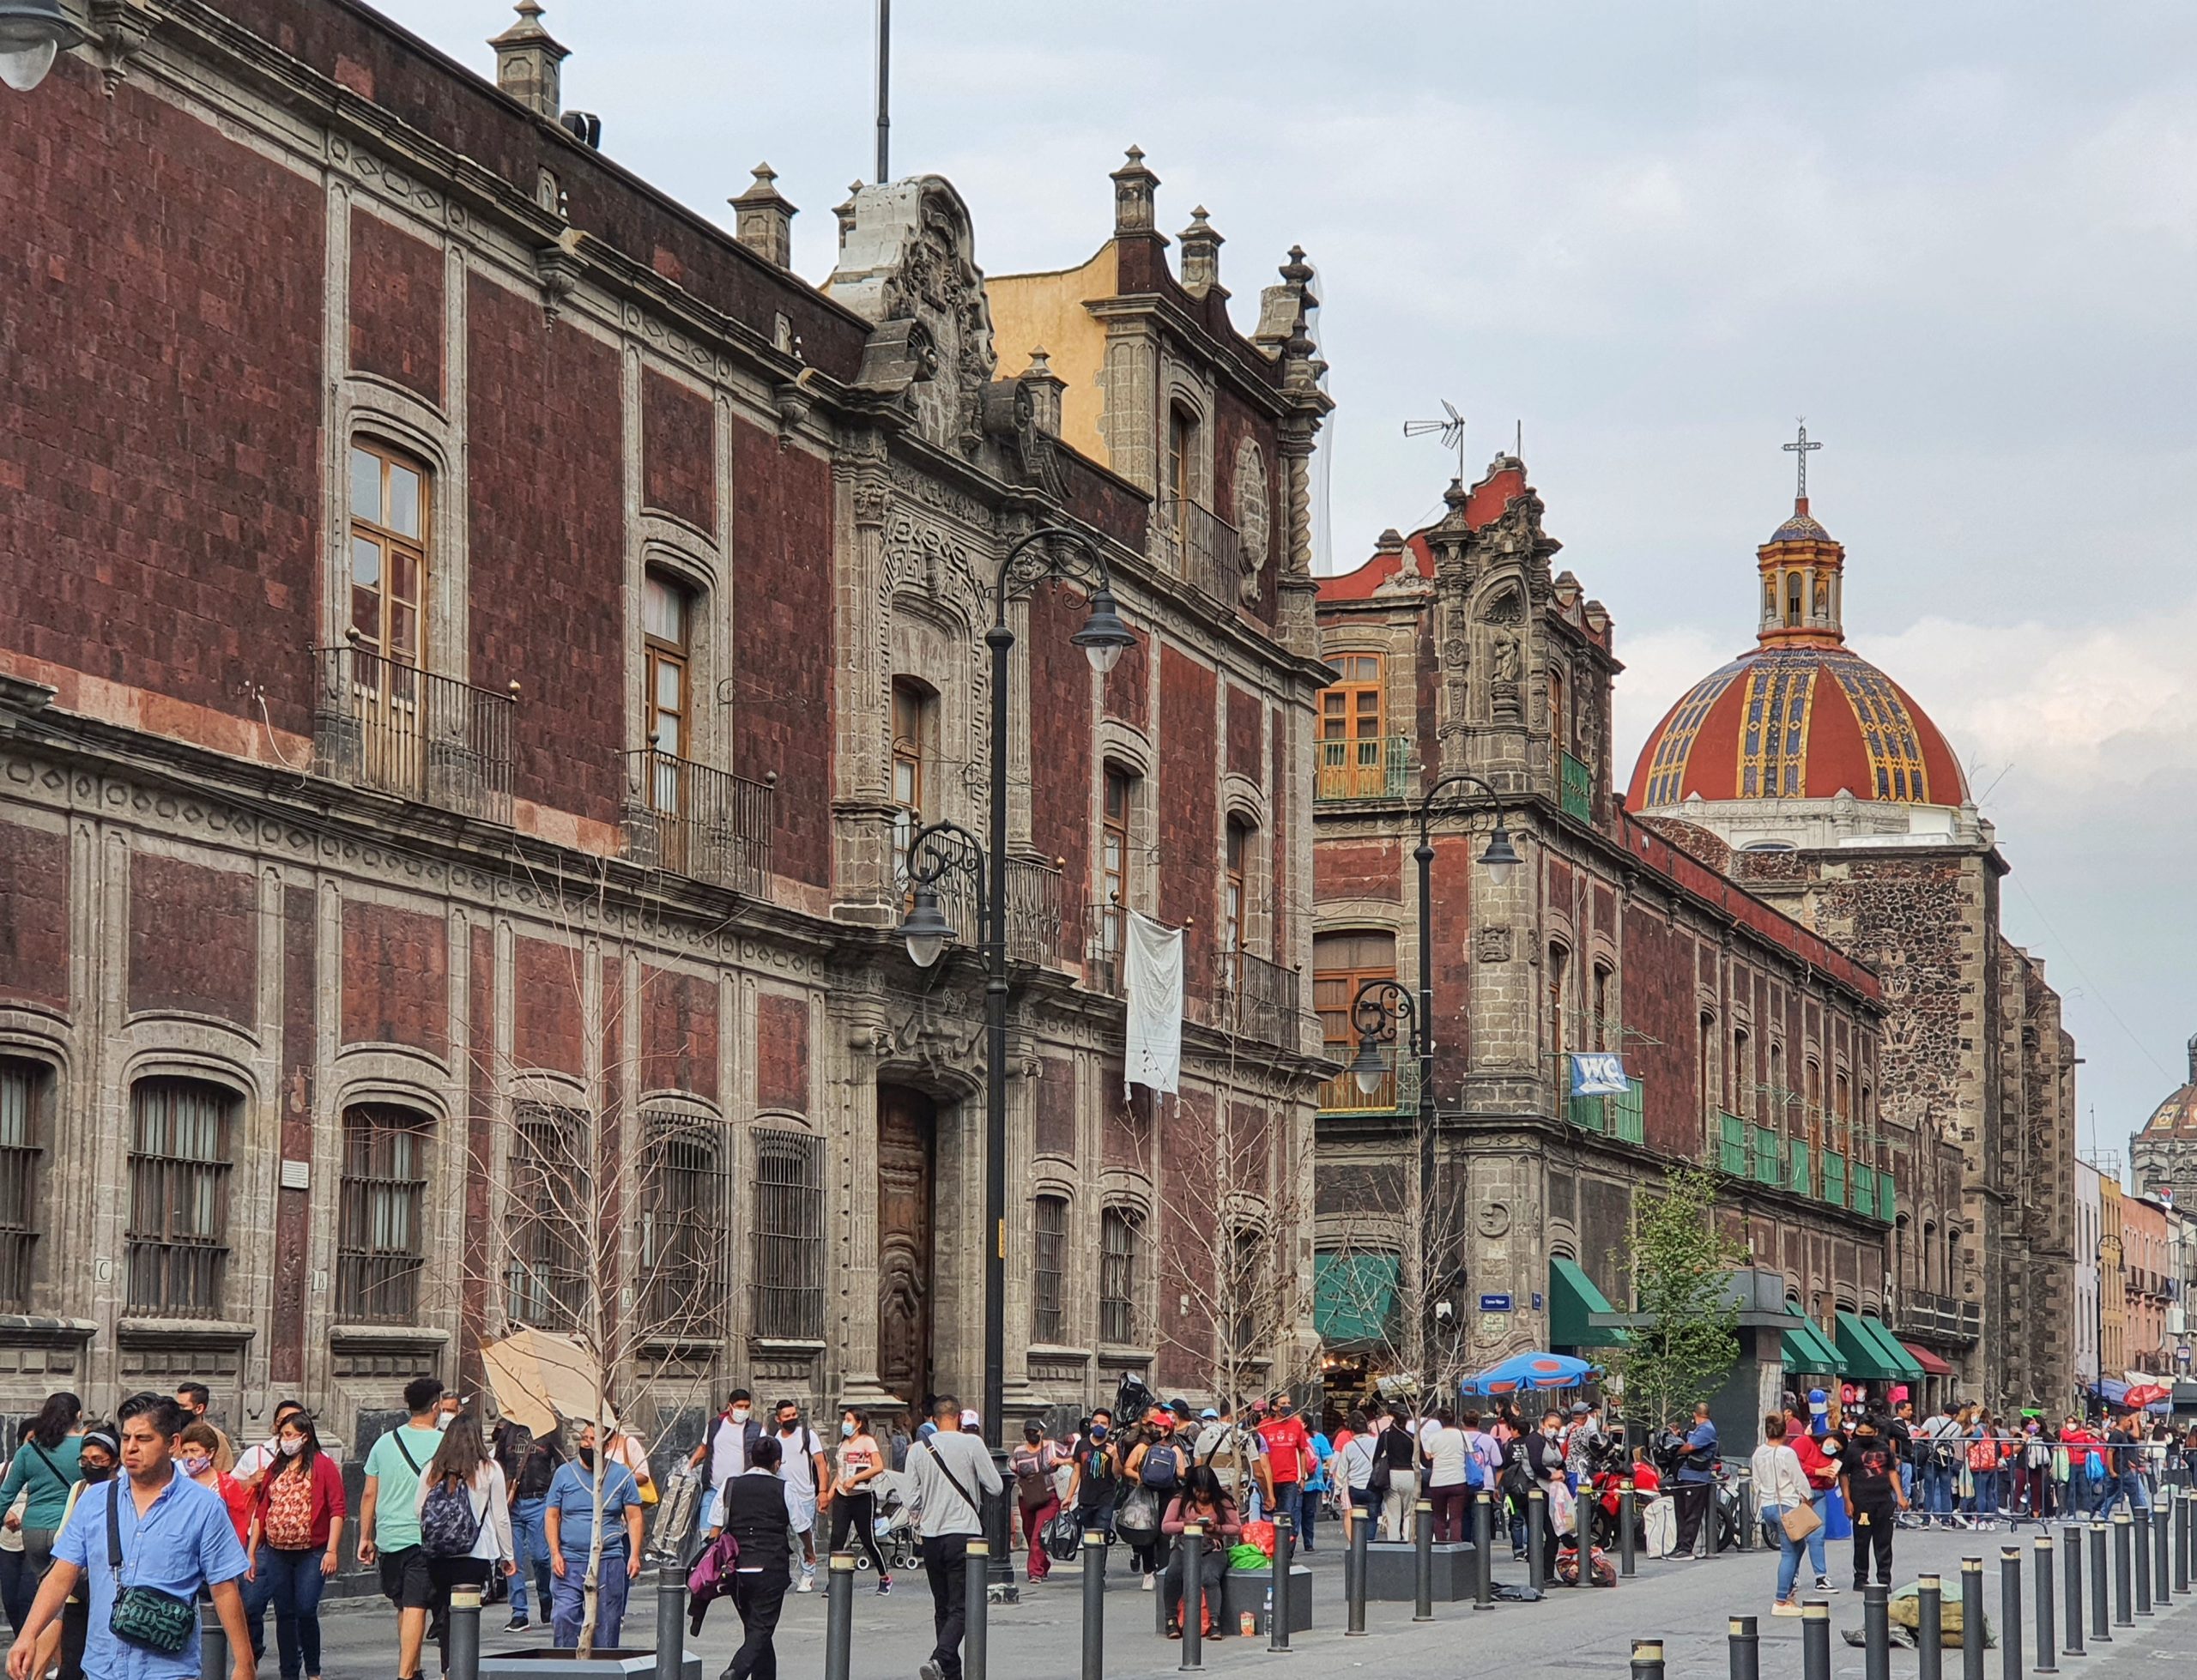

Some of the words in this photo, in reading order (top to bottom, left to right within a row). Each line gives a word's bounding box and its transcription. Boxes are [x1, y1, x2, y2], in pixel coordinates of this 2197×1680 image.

[1580, 1057, 1619, 1082] WC
[99, 1261, 109, 1280] C
[318, 1271, 325, 1289] B
[624, 1290, 632, 1305] A
